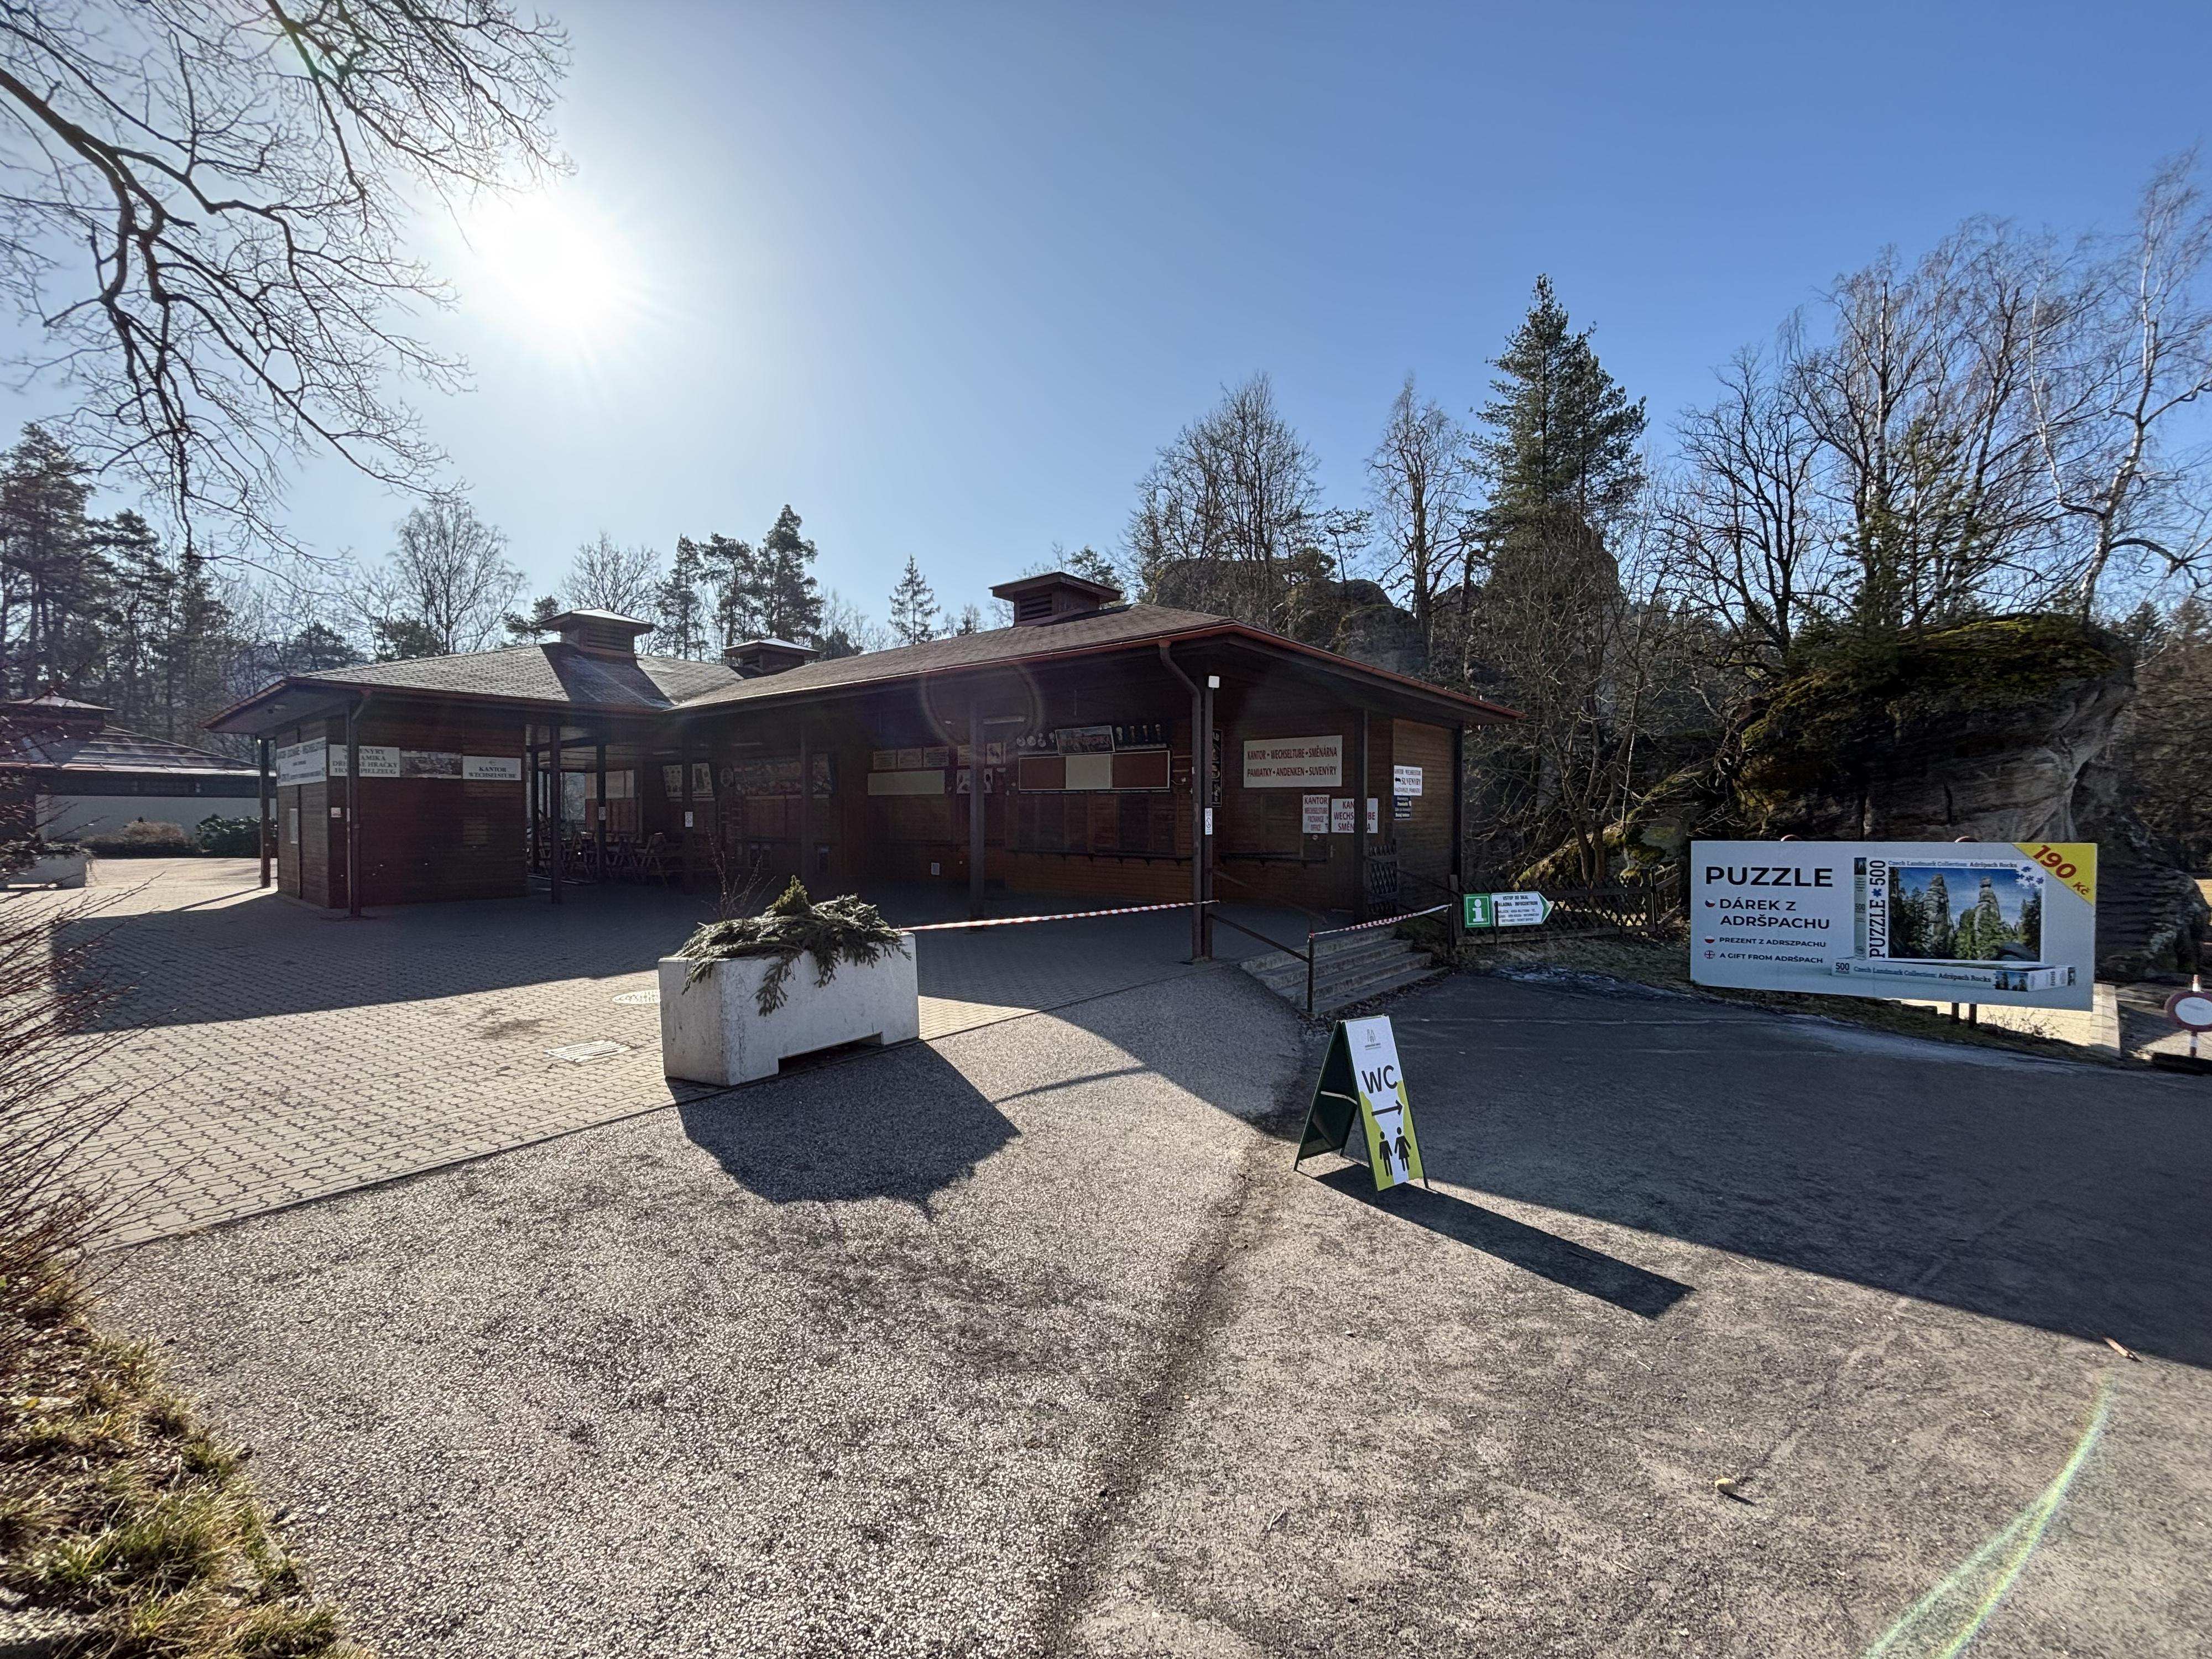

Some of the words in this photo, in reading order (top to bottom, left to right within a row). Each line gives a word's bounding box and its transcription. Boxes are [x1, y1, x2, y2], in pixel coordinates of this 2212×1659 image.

[1248, 750, 1266, 760] KANTOR
[1271, 748, 1305, 759] WECHSELTUBE
[1309, 745, 1337, 758] SMĚNÁRNA
[1248, 768, 1272, 777] PAMIATKY
[1276, 767, 1305, 776] ANDENKEN
[1309, 764, 1337, 775] SUVENÝRY
[1343, 801, 1354, 809] KAN
[1706, 867, 1833, 887] PUZZLE
[1869, 860, 1886, 885] 500
[2033, 844, 2077, 879] 190
[2073, 881, 2090, 895] Kč
[1719, 897, 1781, 910] DÁREK
[1785, 901, 1796, 911] Z
[1720, 914, 1830, 930] ADRŠPACHU
[1869, 900, 1886, 958] PUZZLE
[1774, 954, 1823, 963] ADRŠPACH
[1835, 962, 1850, 971] 500
[1361, 1065, 1398, 1094] WC
